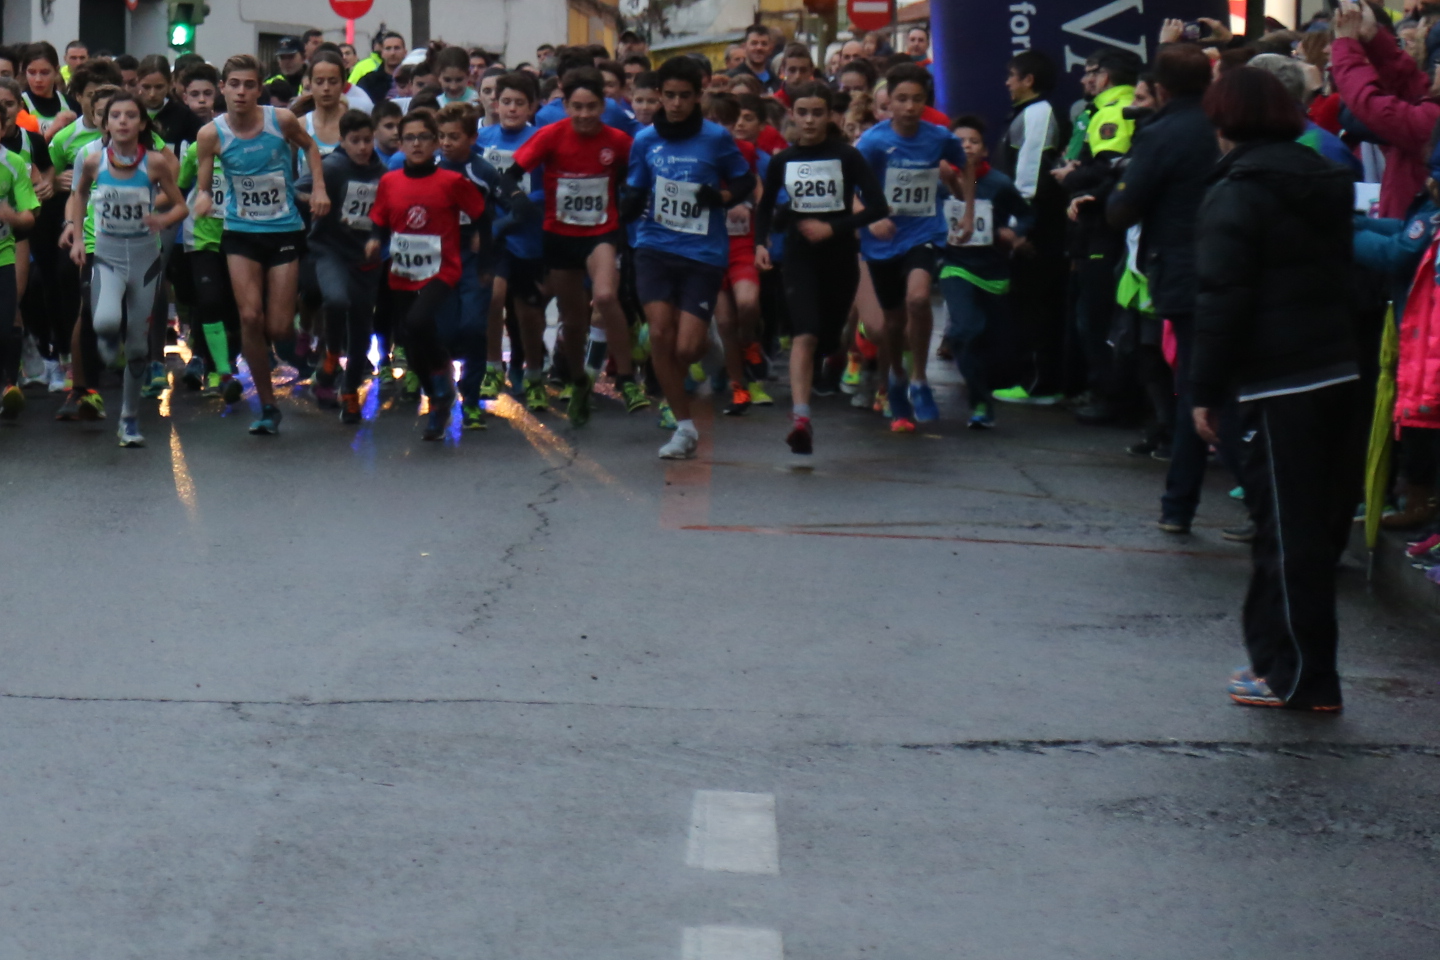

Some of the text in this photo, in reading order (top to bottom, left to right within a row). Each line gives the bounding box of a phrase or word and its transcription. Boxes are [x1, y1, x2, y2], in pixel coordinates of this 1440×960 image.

[1008, 1, 1037, 57] for
[794, 180, 837, 197] 2264
[892, 187, 930, 203] 2191
[242, 189, 280, 207] 2432
[102, 201, 143, 219] 2433
[661, 197, 702, 218] 2190
